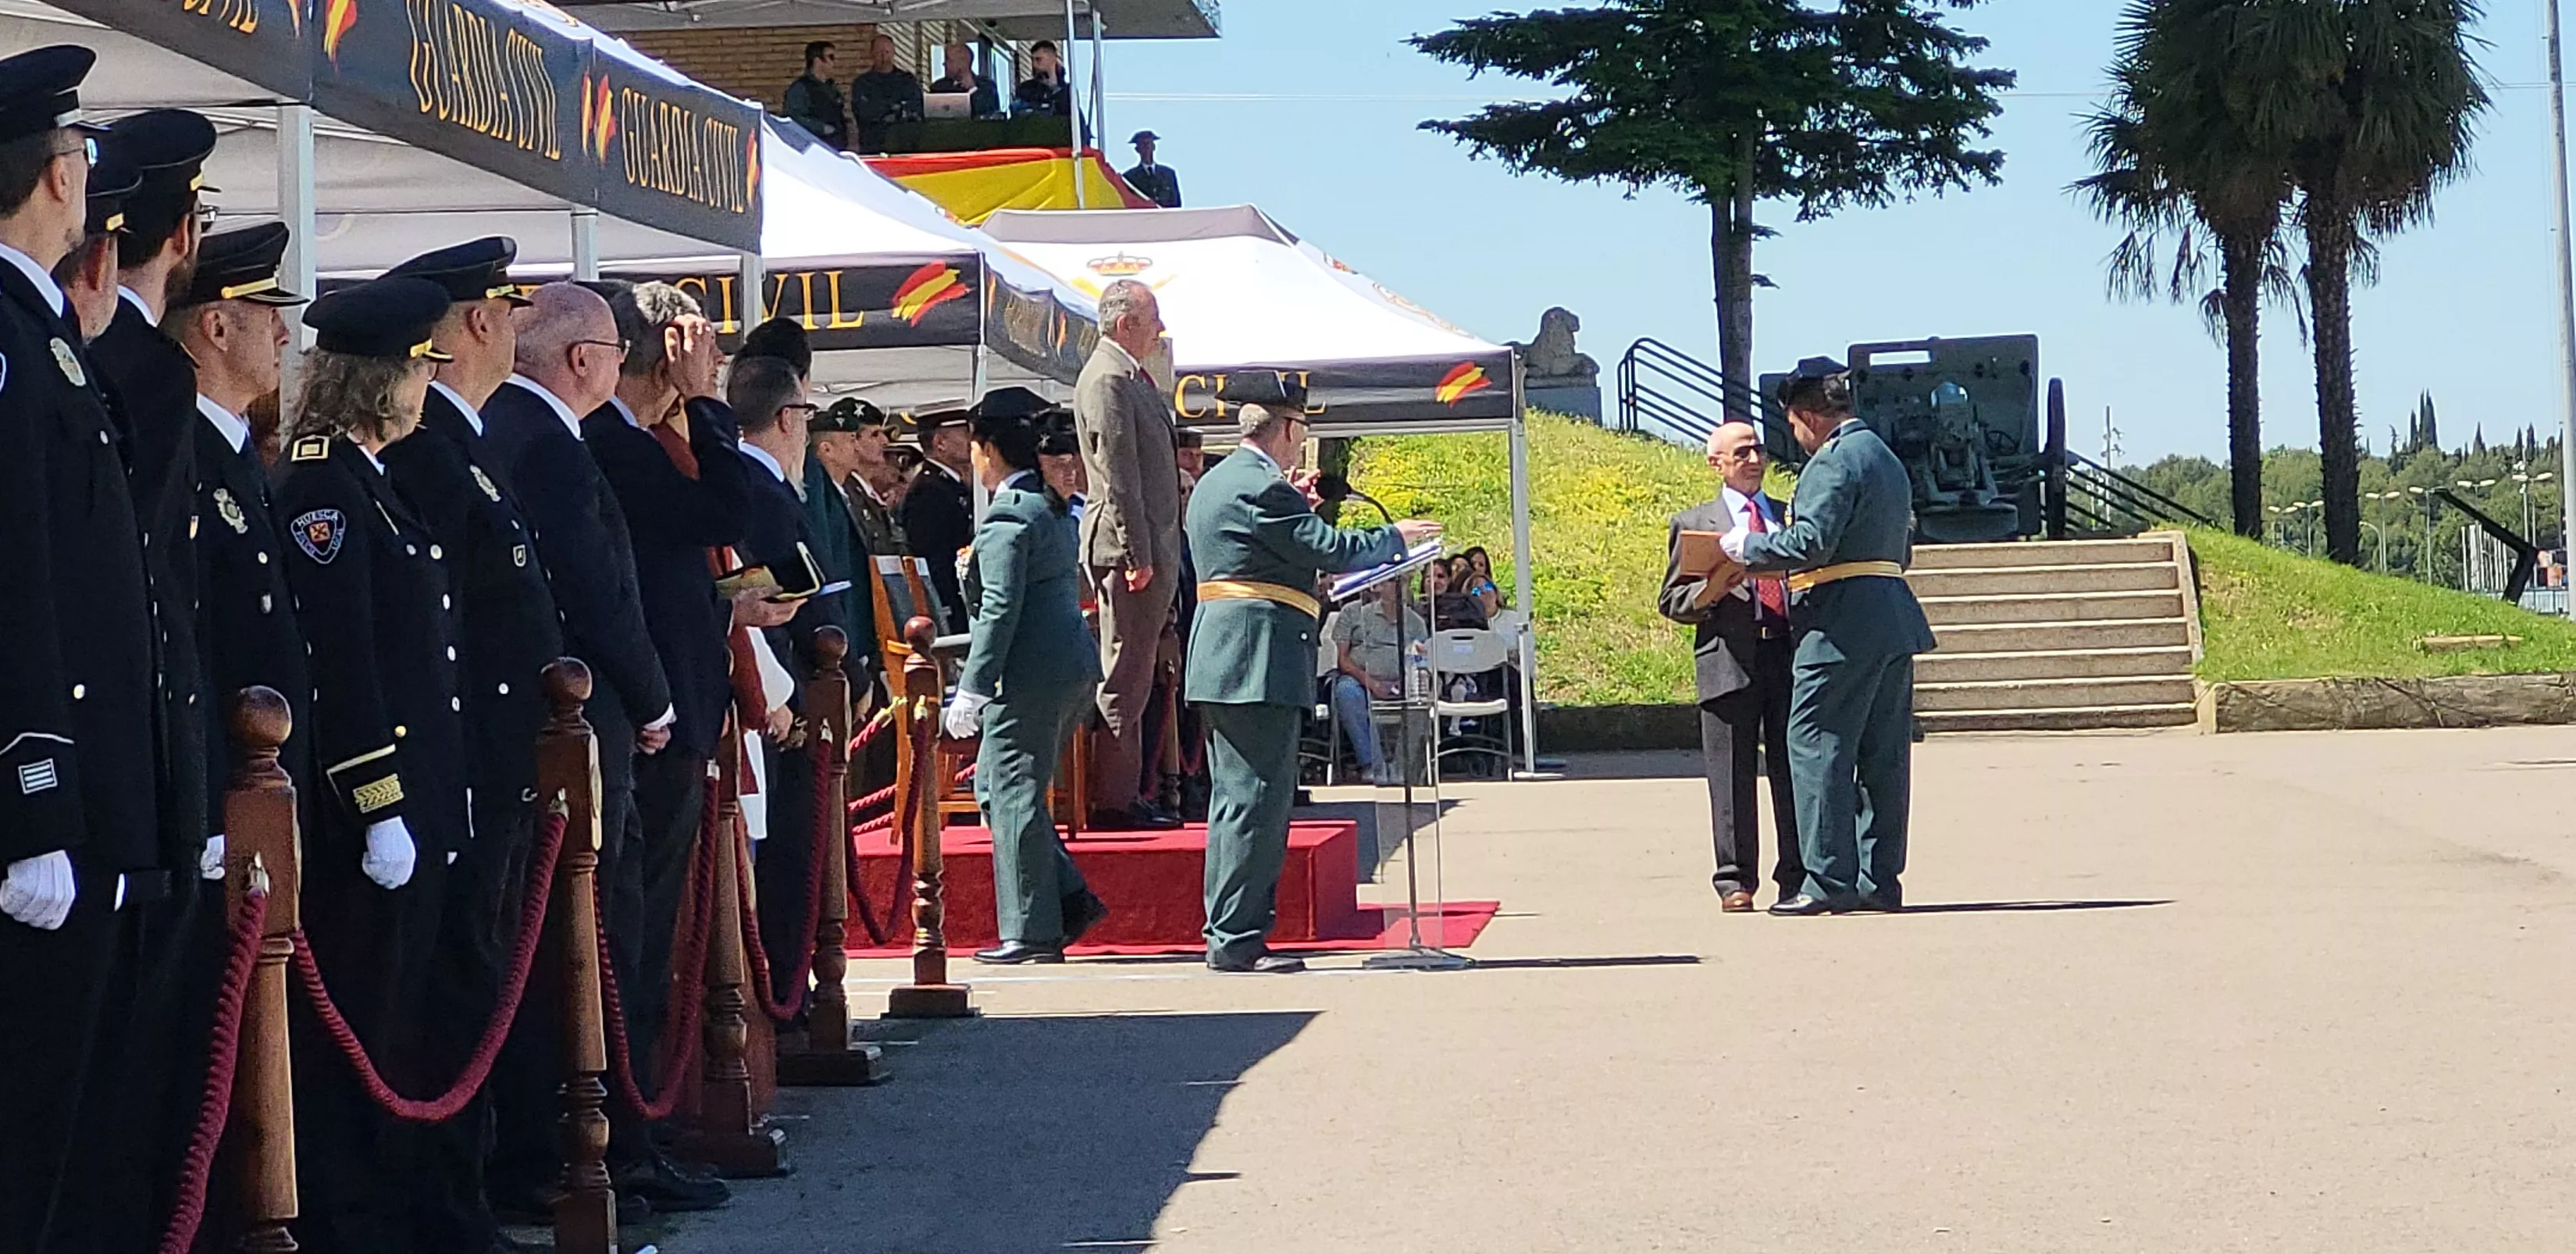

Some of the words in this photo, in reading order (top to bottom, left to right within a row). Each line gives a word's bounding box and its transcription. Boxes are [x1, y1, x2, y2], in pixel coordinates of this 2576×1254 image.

[406, 0, 512, 141] GUARDIA
[506, 28, 561, 160] CIVIL
[622, 87, 704, 203] GUARDIA
[704, 117, 744, 214] CIVIL
